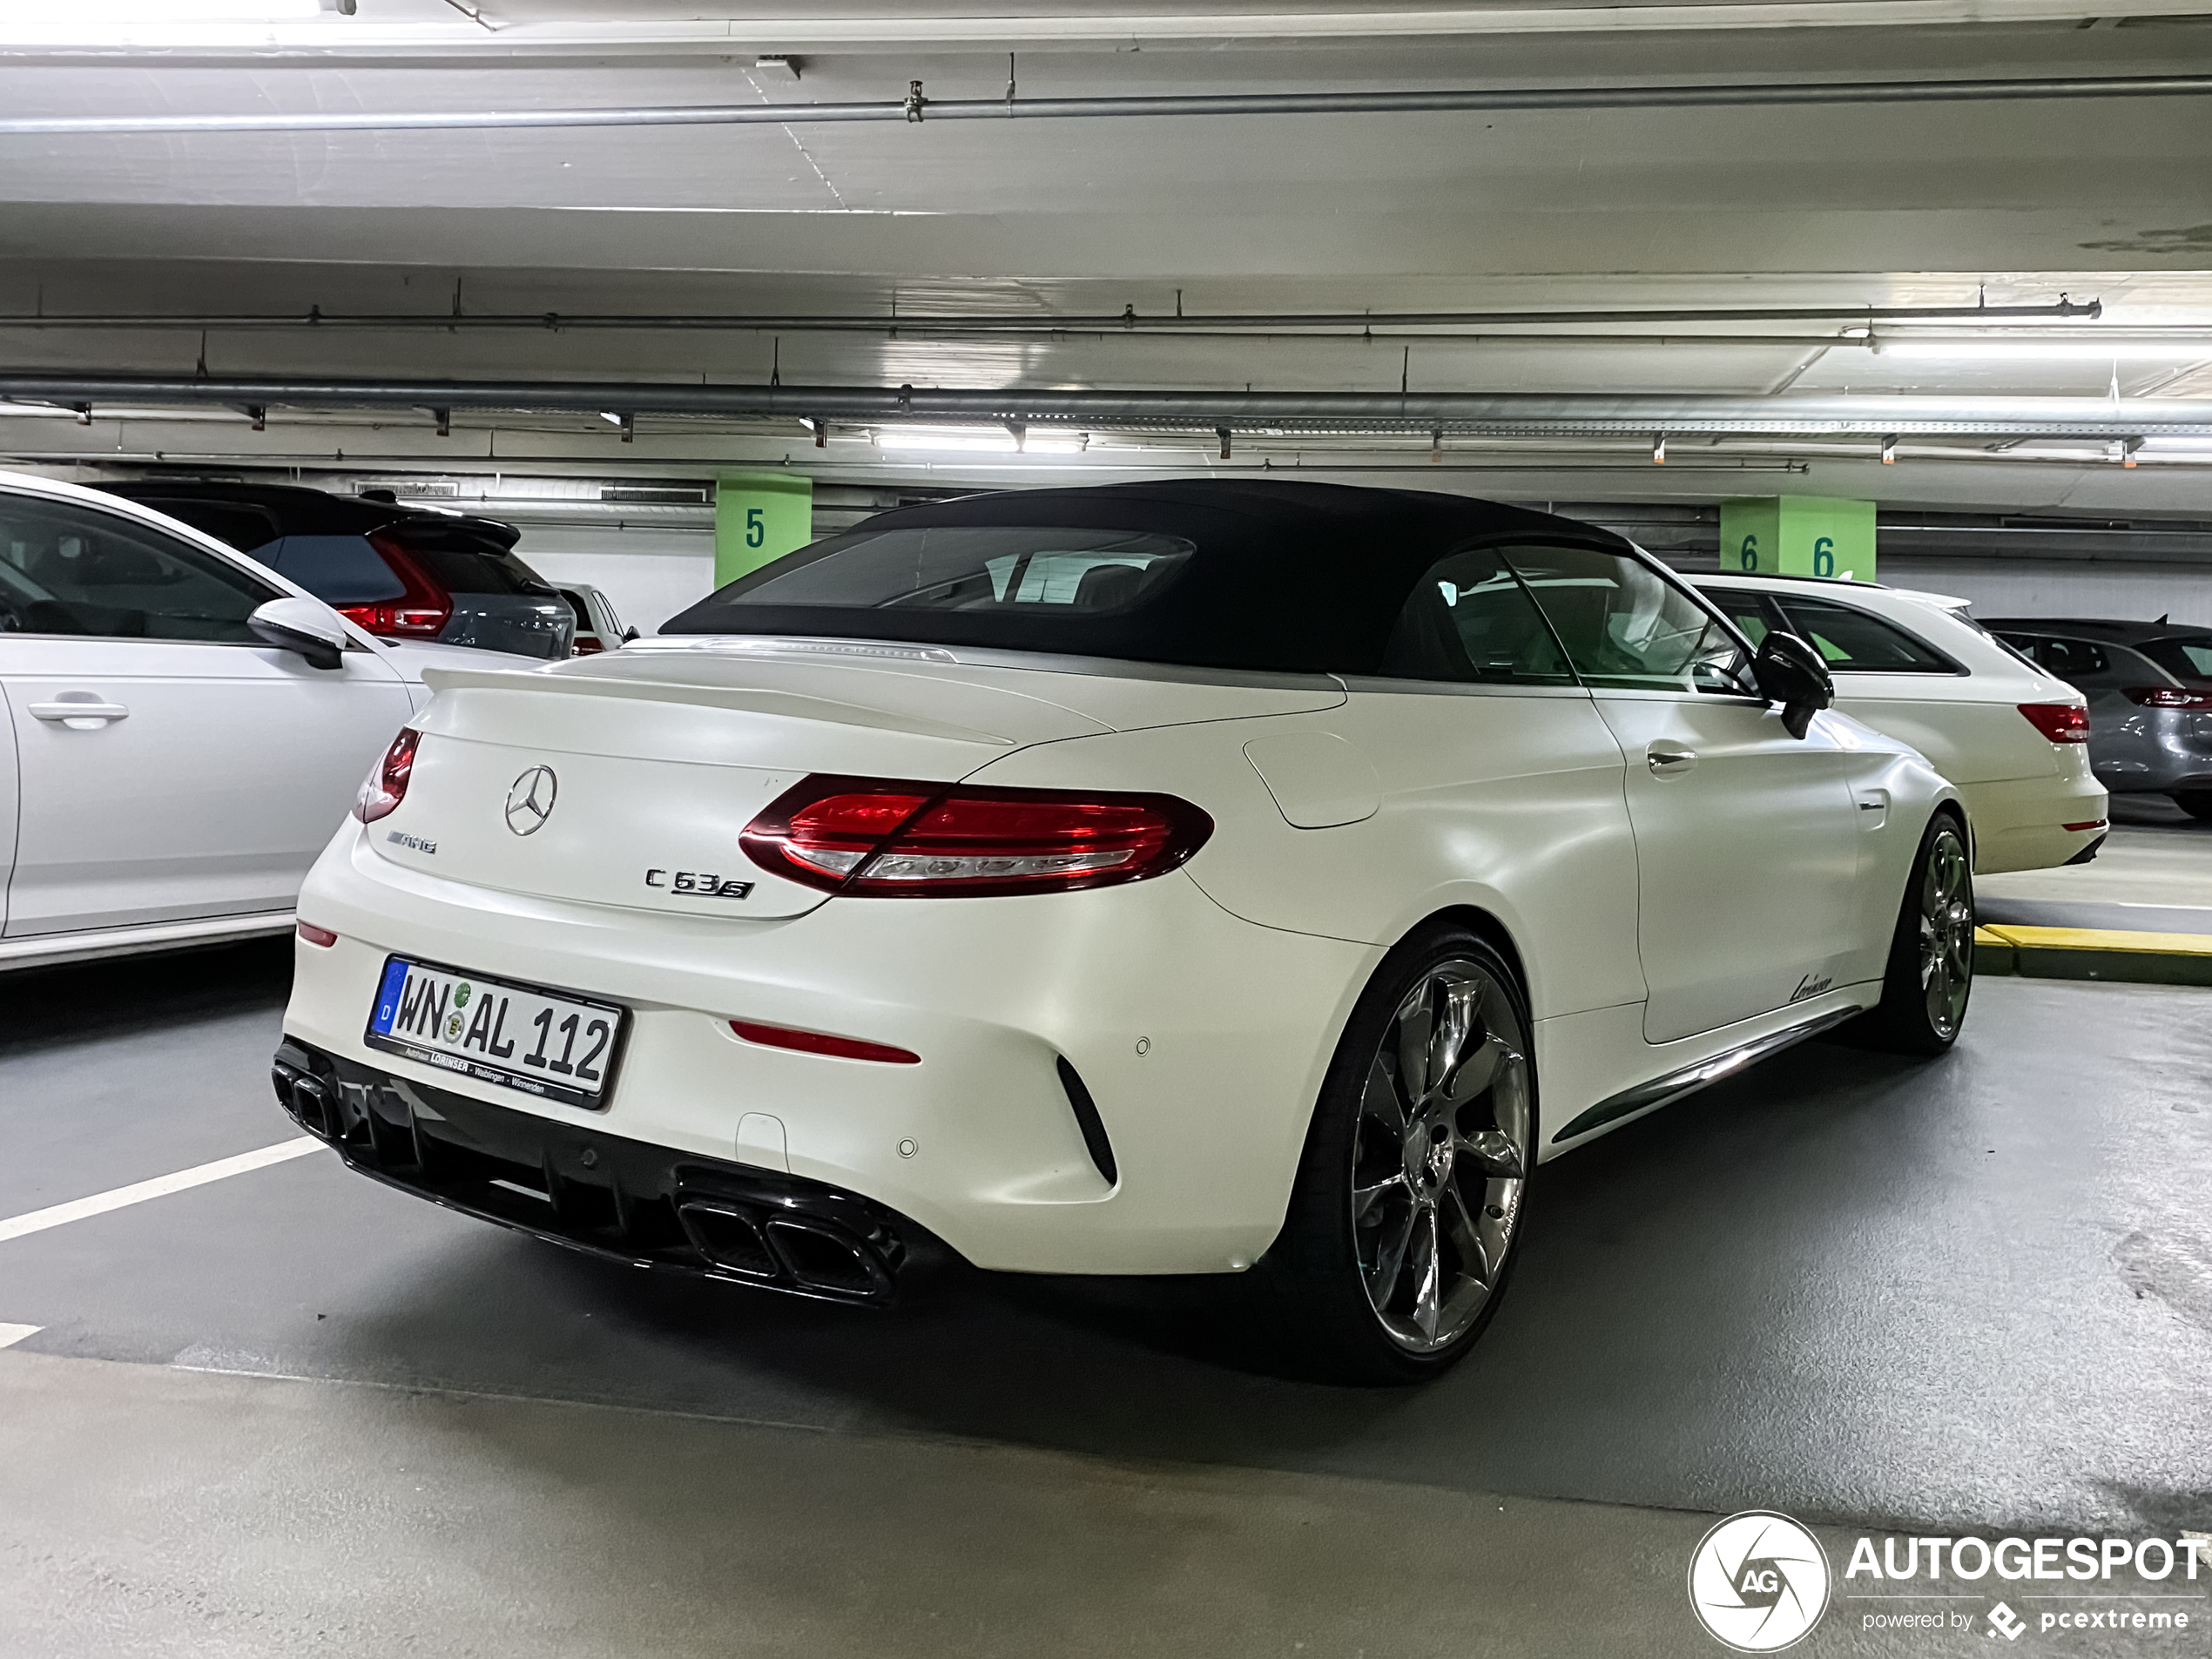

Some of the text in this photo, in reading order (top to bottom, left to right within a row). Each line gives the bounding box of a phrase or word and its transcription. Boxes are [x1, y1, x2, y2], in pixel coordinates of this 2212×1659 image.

[746, 509, 764, 548] 5
[1741, 535, 1757, 572] 6
[1813, 536, 1834, 577] 6
[645, 868, 667, 888] C
[381, 1004, 391, 1021] D
[523, 1008, 610, 1082] 112
[430, 1053, 469, 1073] LORINSER
[475, 1067, 505, 1083] Waiblingen
[511, 1076, 545, 1094] Winnenden
